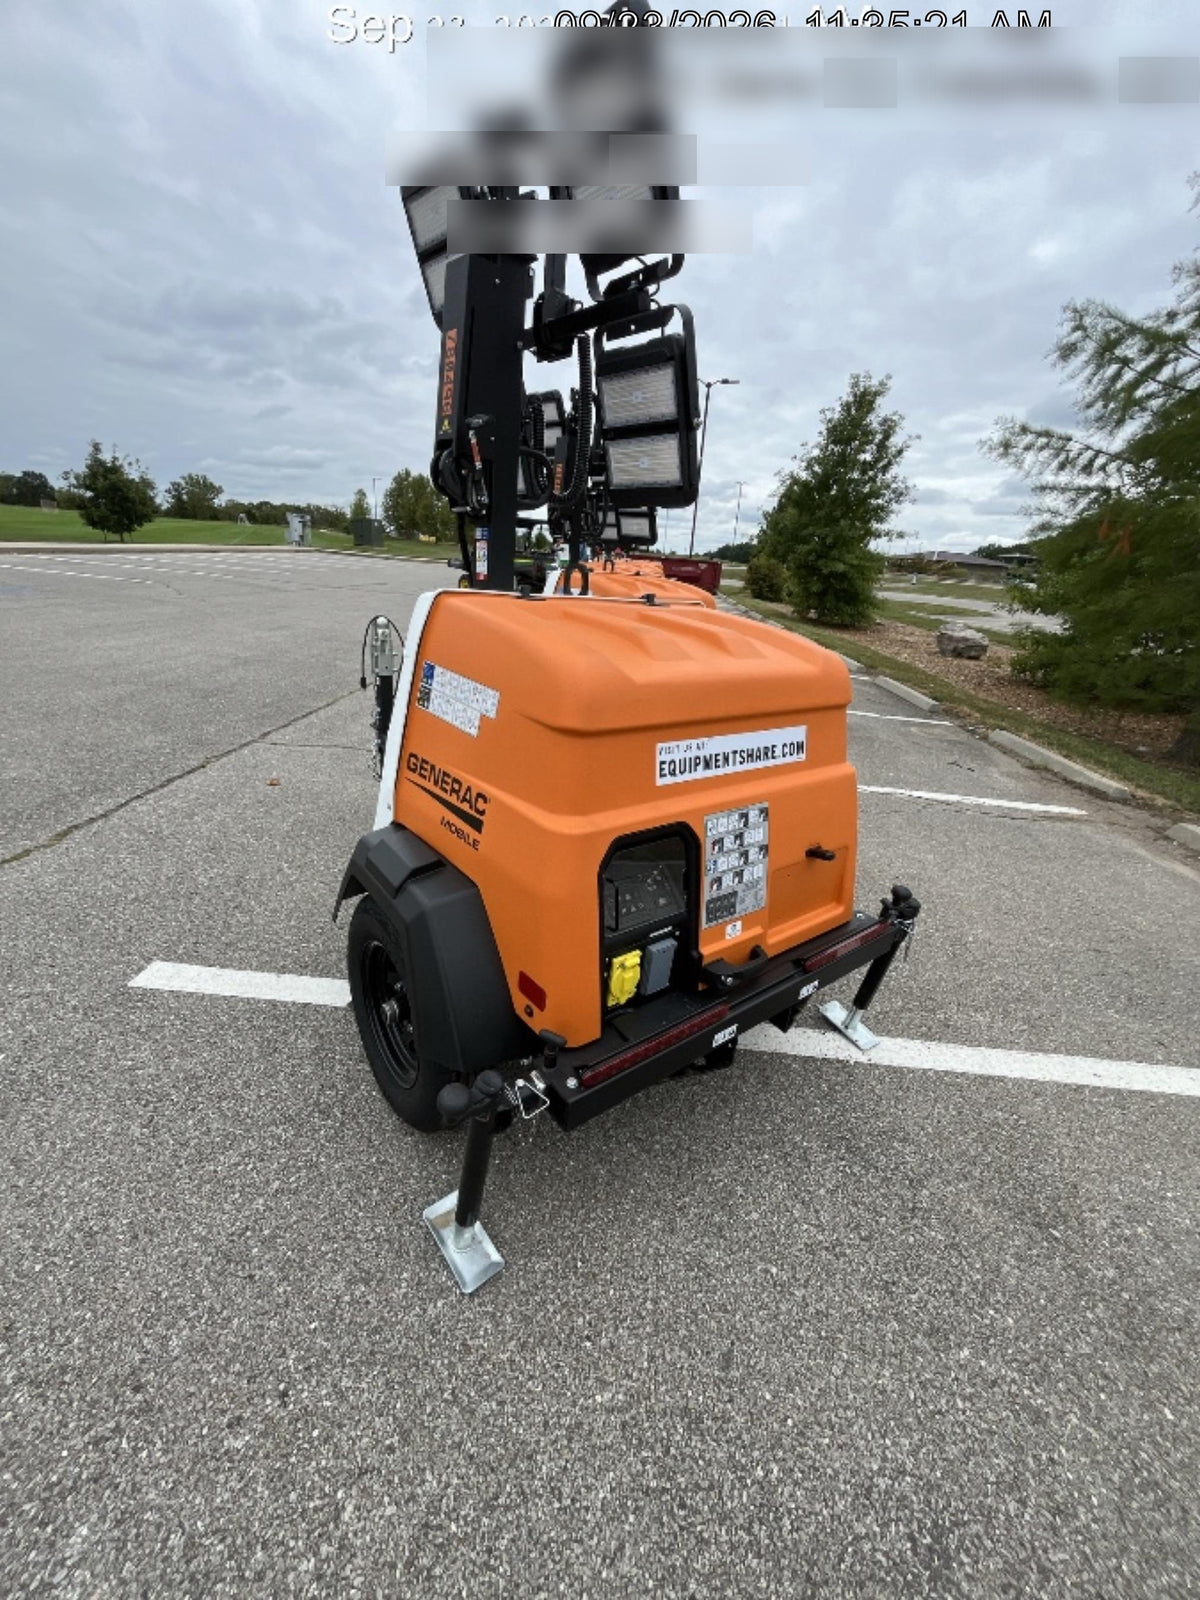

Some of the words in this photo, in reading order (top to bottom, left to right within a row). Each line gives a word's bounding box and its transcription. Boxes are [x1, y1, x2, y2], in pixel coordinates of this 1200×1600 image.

[659, 740, 805, 778] EQUIPMENTSHARE.COM
[406, 752, 488, 816] GENERAC
[440, 815, 480, 851] MOBILE
